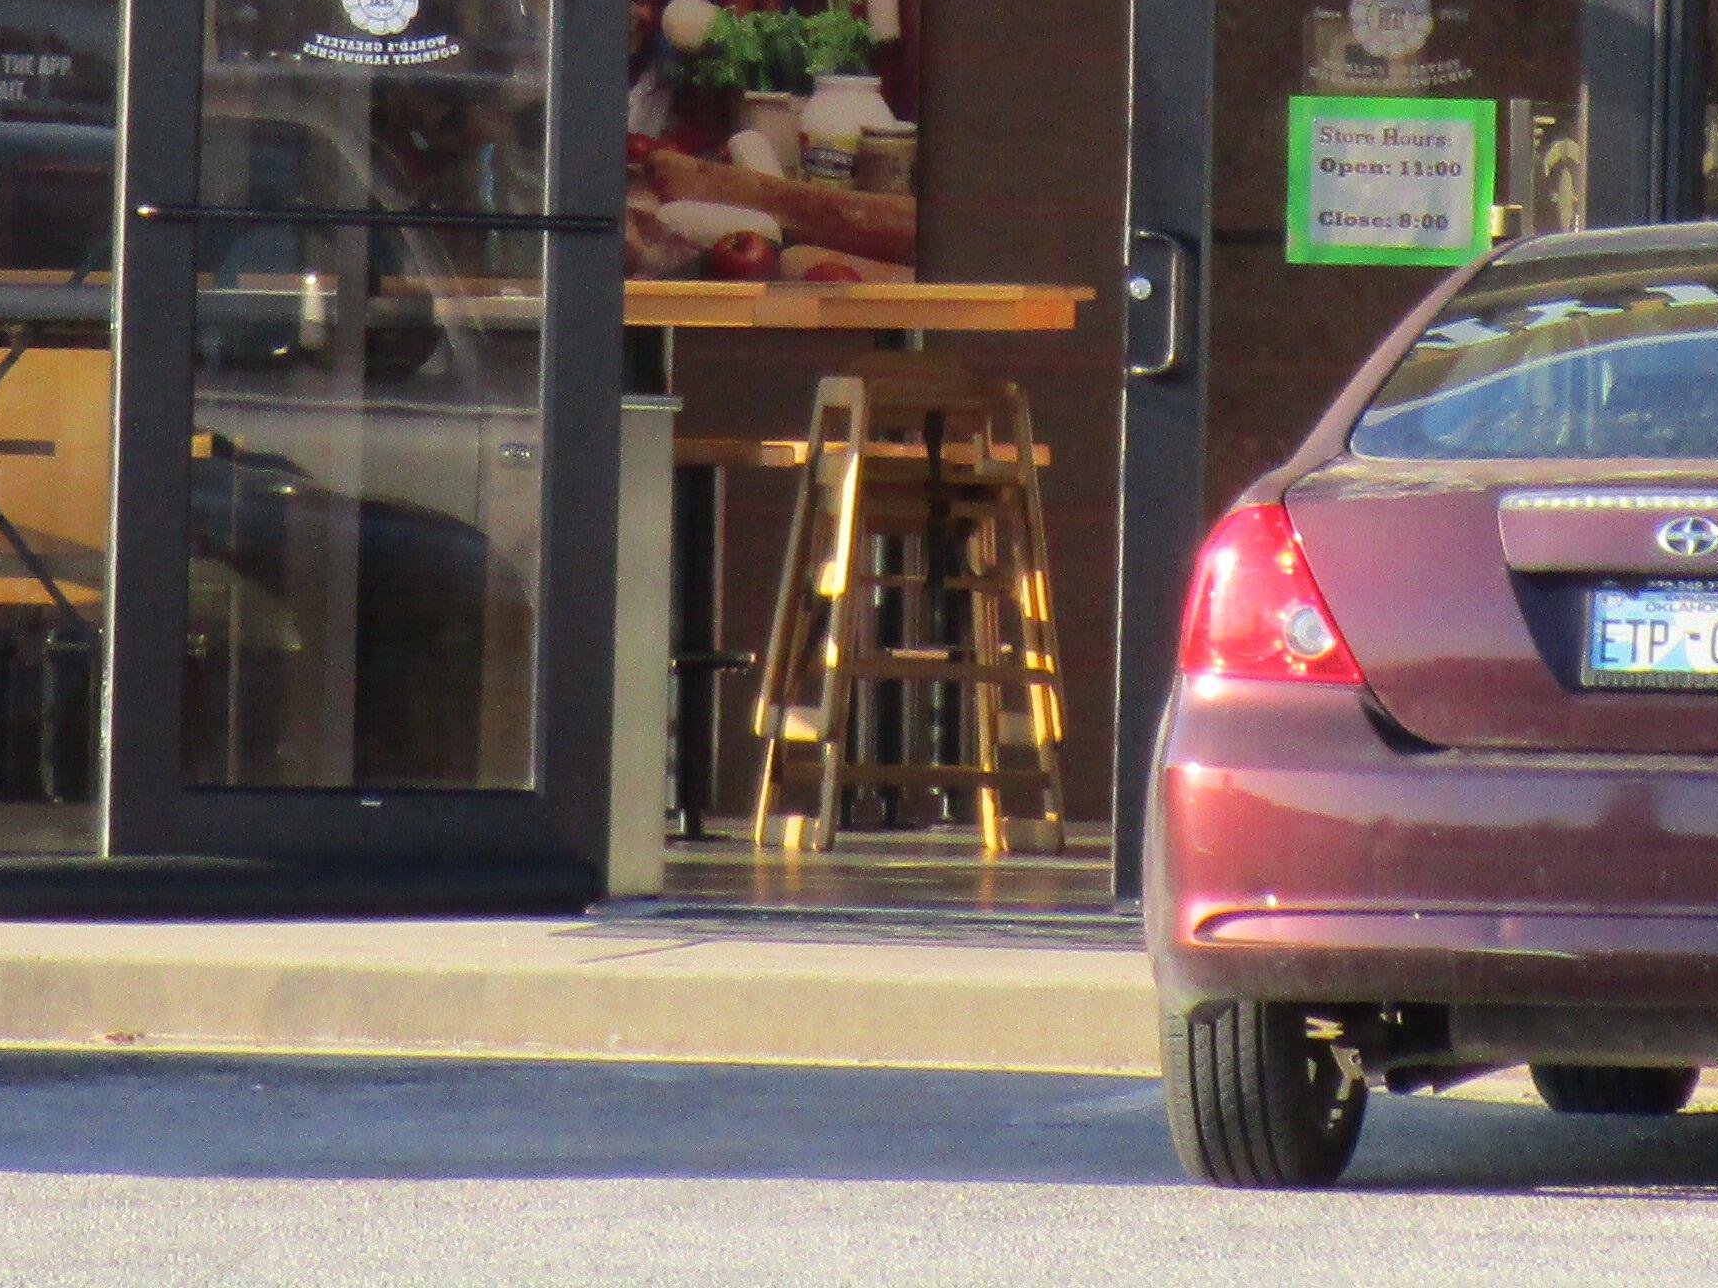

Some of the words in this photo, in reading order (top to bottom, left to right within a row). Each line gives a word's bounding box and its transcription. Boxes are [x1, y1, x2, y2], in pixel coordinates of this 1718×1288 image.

[1319, 126, 1376, 147] Store
[1319, 158, 1392, 178] Open:
[1400, 159, 1462, 179] 11:00
[1318, 211, 1392, 230] Close:
[1398, 212, 1449, 231] 8:00
